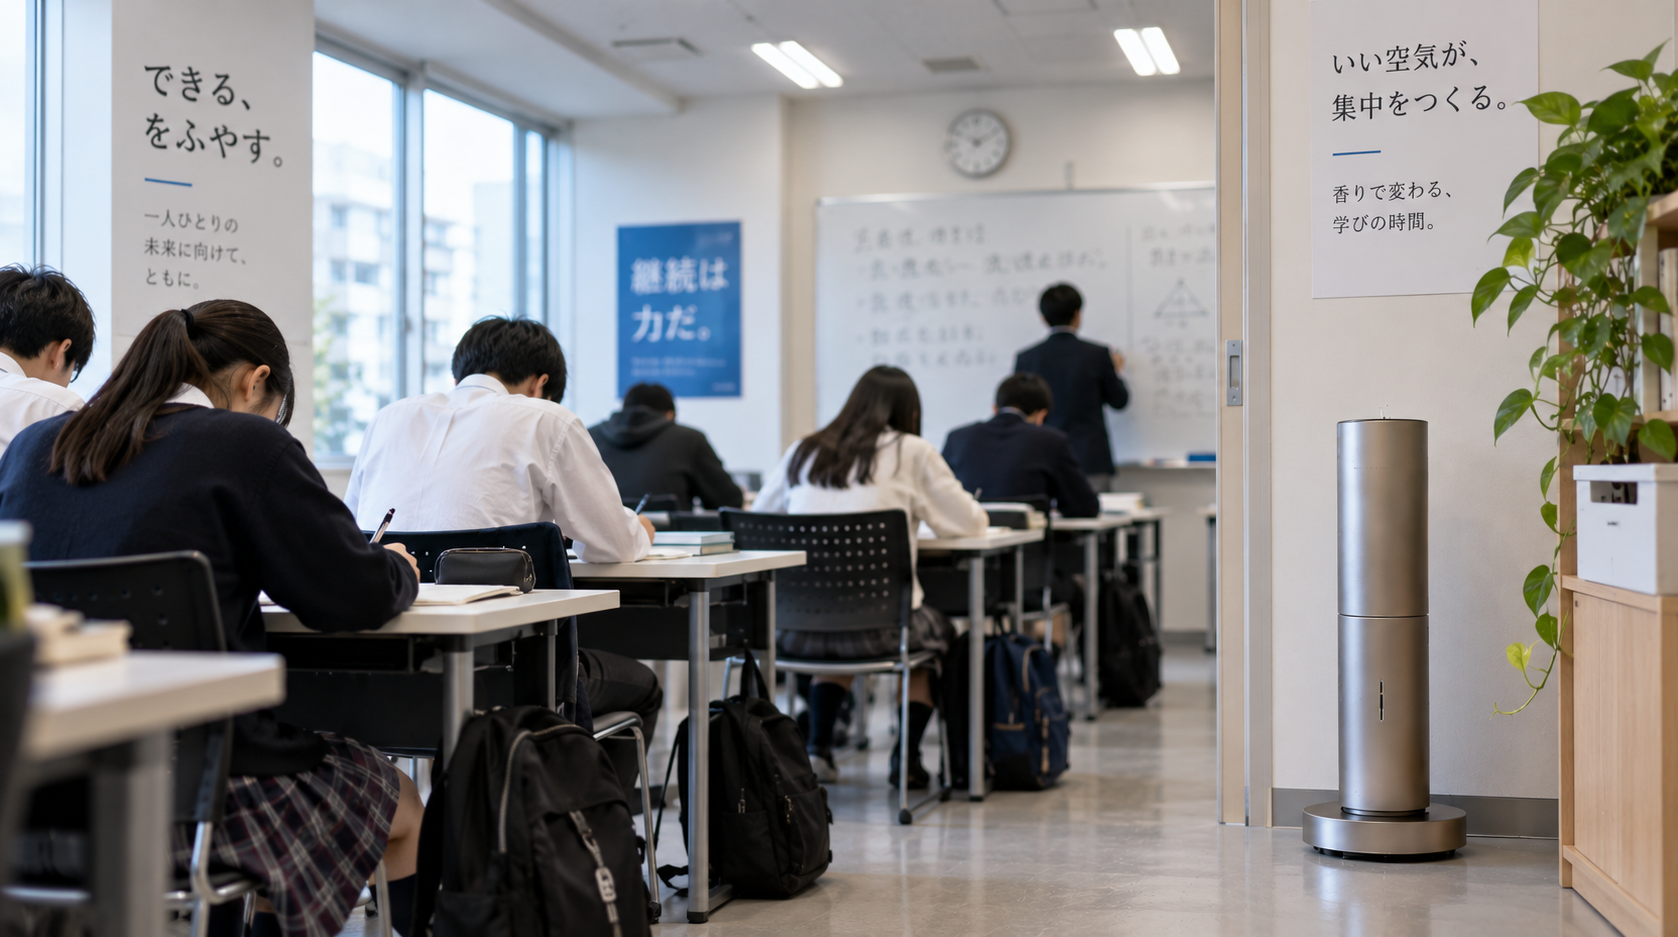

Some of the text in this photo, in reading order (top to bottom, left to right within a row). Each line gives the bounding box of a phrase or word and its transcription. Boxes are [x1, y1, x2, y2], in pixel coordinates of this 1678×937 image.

[1332, 40, 1479, 74] いい空気が、
[144, 65, 251, 111] できる、
[1332, 84, 1507, 122] 集中をつくる。
[144, 112, 283, 168] をふやす。
[1332, 180, 1453, 204] 香りで変わる、
[144, 209, 239, 234] 一人ひとりの
[1332, 211, 1435, 235] 学びの時間。
[144, 237, 247, 265] 未来に向けて、
[145, 268, 200, 290] ともに。
[630, 256, 729, 295] 継続は
[631, 303, 712, 343] 力だ。
